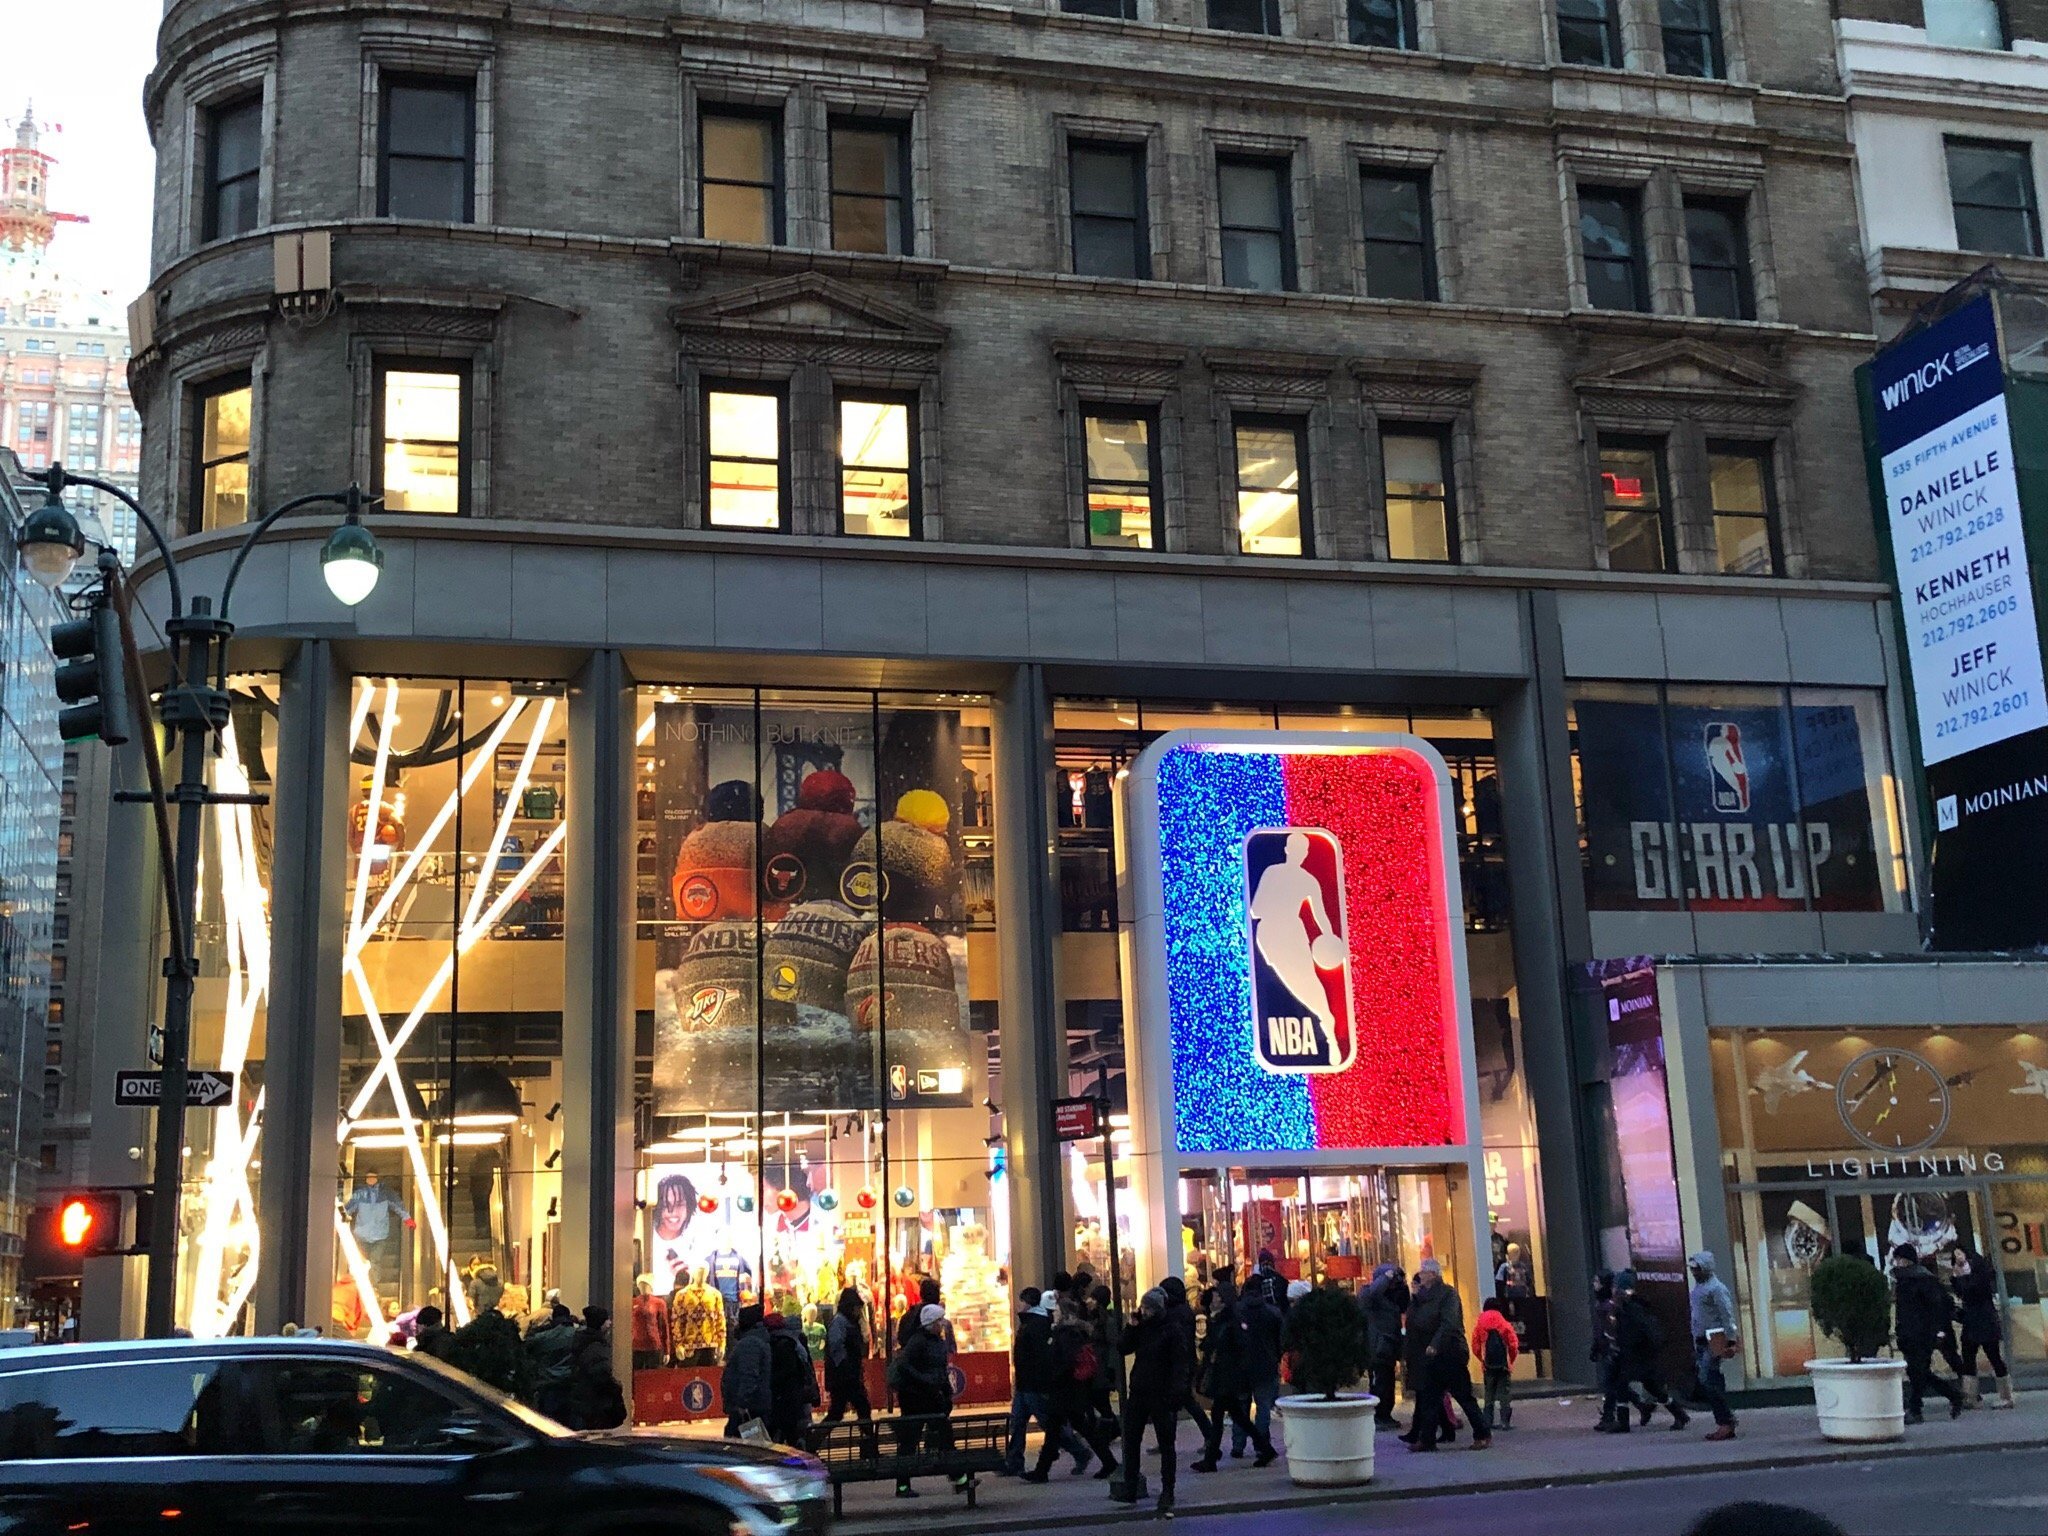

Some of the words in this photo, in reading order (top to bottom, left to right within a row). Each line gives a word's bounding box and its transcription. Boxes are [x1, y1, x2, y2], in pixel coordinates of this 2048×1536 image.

[1892, 459, 1911, 478] 535
[1914, 441, 1947, 466] FIFTH
[1951, 413, 1998, 448] AVENUE
[1900, 450, 2000, 516] DANIELLE
[1918, 485, 1988, 534] WINICK
[1910, 507, 2005, 563] 212.792.2628
[1915, 546, 2010, 605] KENNETH
[1920, 574, 2012, 624] HOCHHAUSER
[1922, 595, 2017, 648] 212.792.2605
[1950, 642, 1997, 678] JEFF
[1942, 666, 2013, 708] WINICK
[766, 724, 806, 744] BUT
[811, 726, 854, 745] KNIT
[1936, 691, 2029, 738] 212.792.2601
[1964, 774, 2048, 816] MOINIAN
[1767, 822, 1831, 899] UP
[1267, 1016, 1319, 1056] NBA
[126, 1080, 161, 1096] ONE
[187, 1081, 220, 1096] WAY
[1807, 1152, 2005, 1178] LIGHTNING
